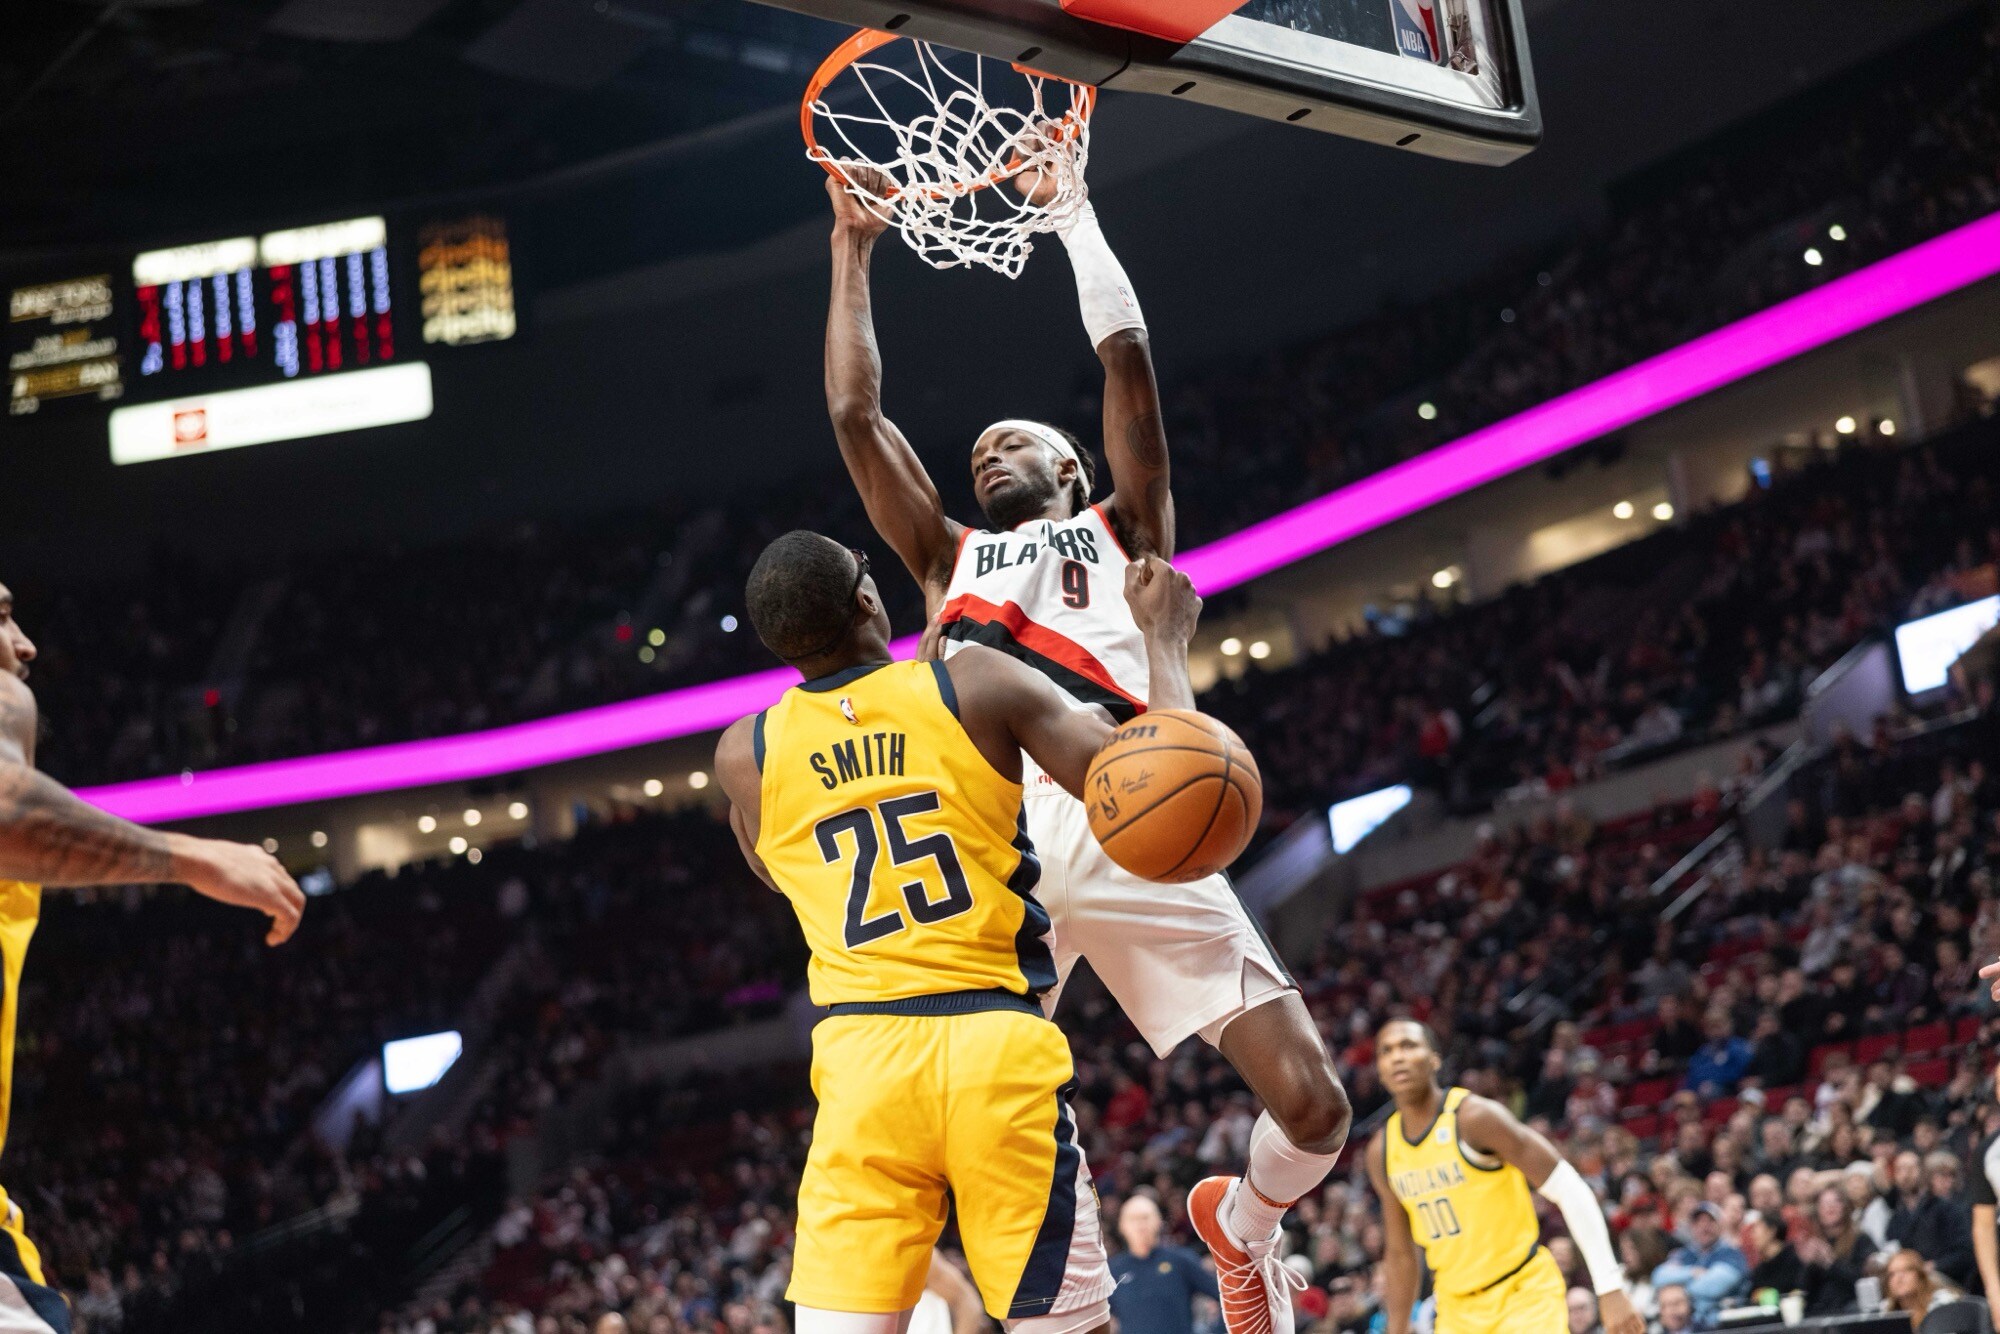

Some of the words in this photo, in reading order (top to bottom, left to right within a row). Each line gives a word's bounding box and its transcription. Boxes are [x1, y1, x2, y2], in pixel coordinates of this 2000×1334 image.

[1401, 28, 1425, 53] NBA
[974, 521, 1099, 579] BLARS
[1062, 559, 1090, 610] 9
[809, 732, 906, 790] SMITH
[814, 790, 974, 950] 25
[1417, 1197, 1461, 1240] 00
